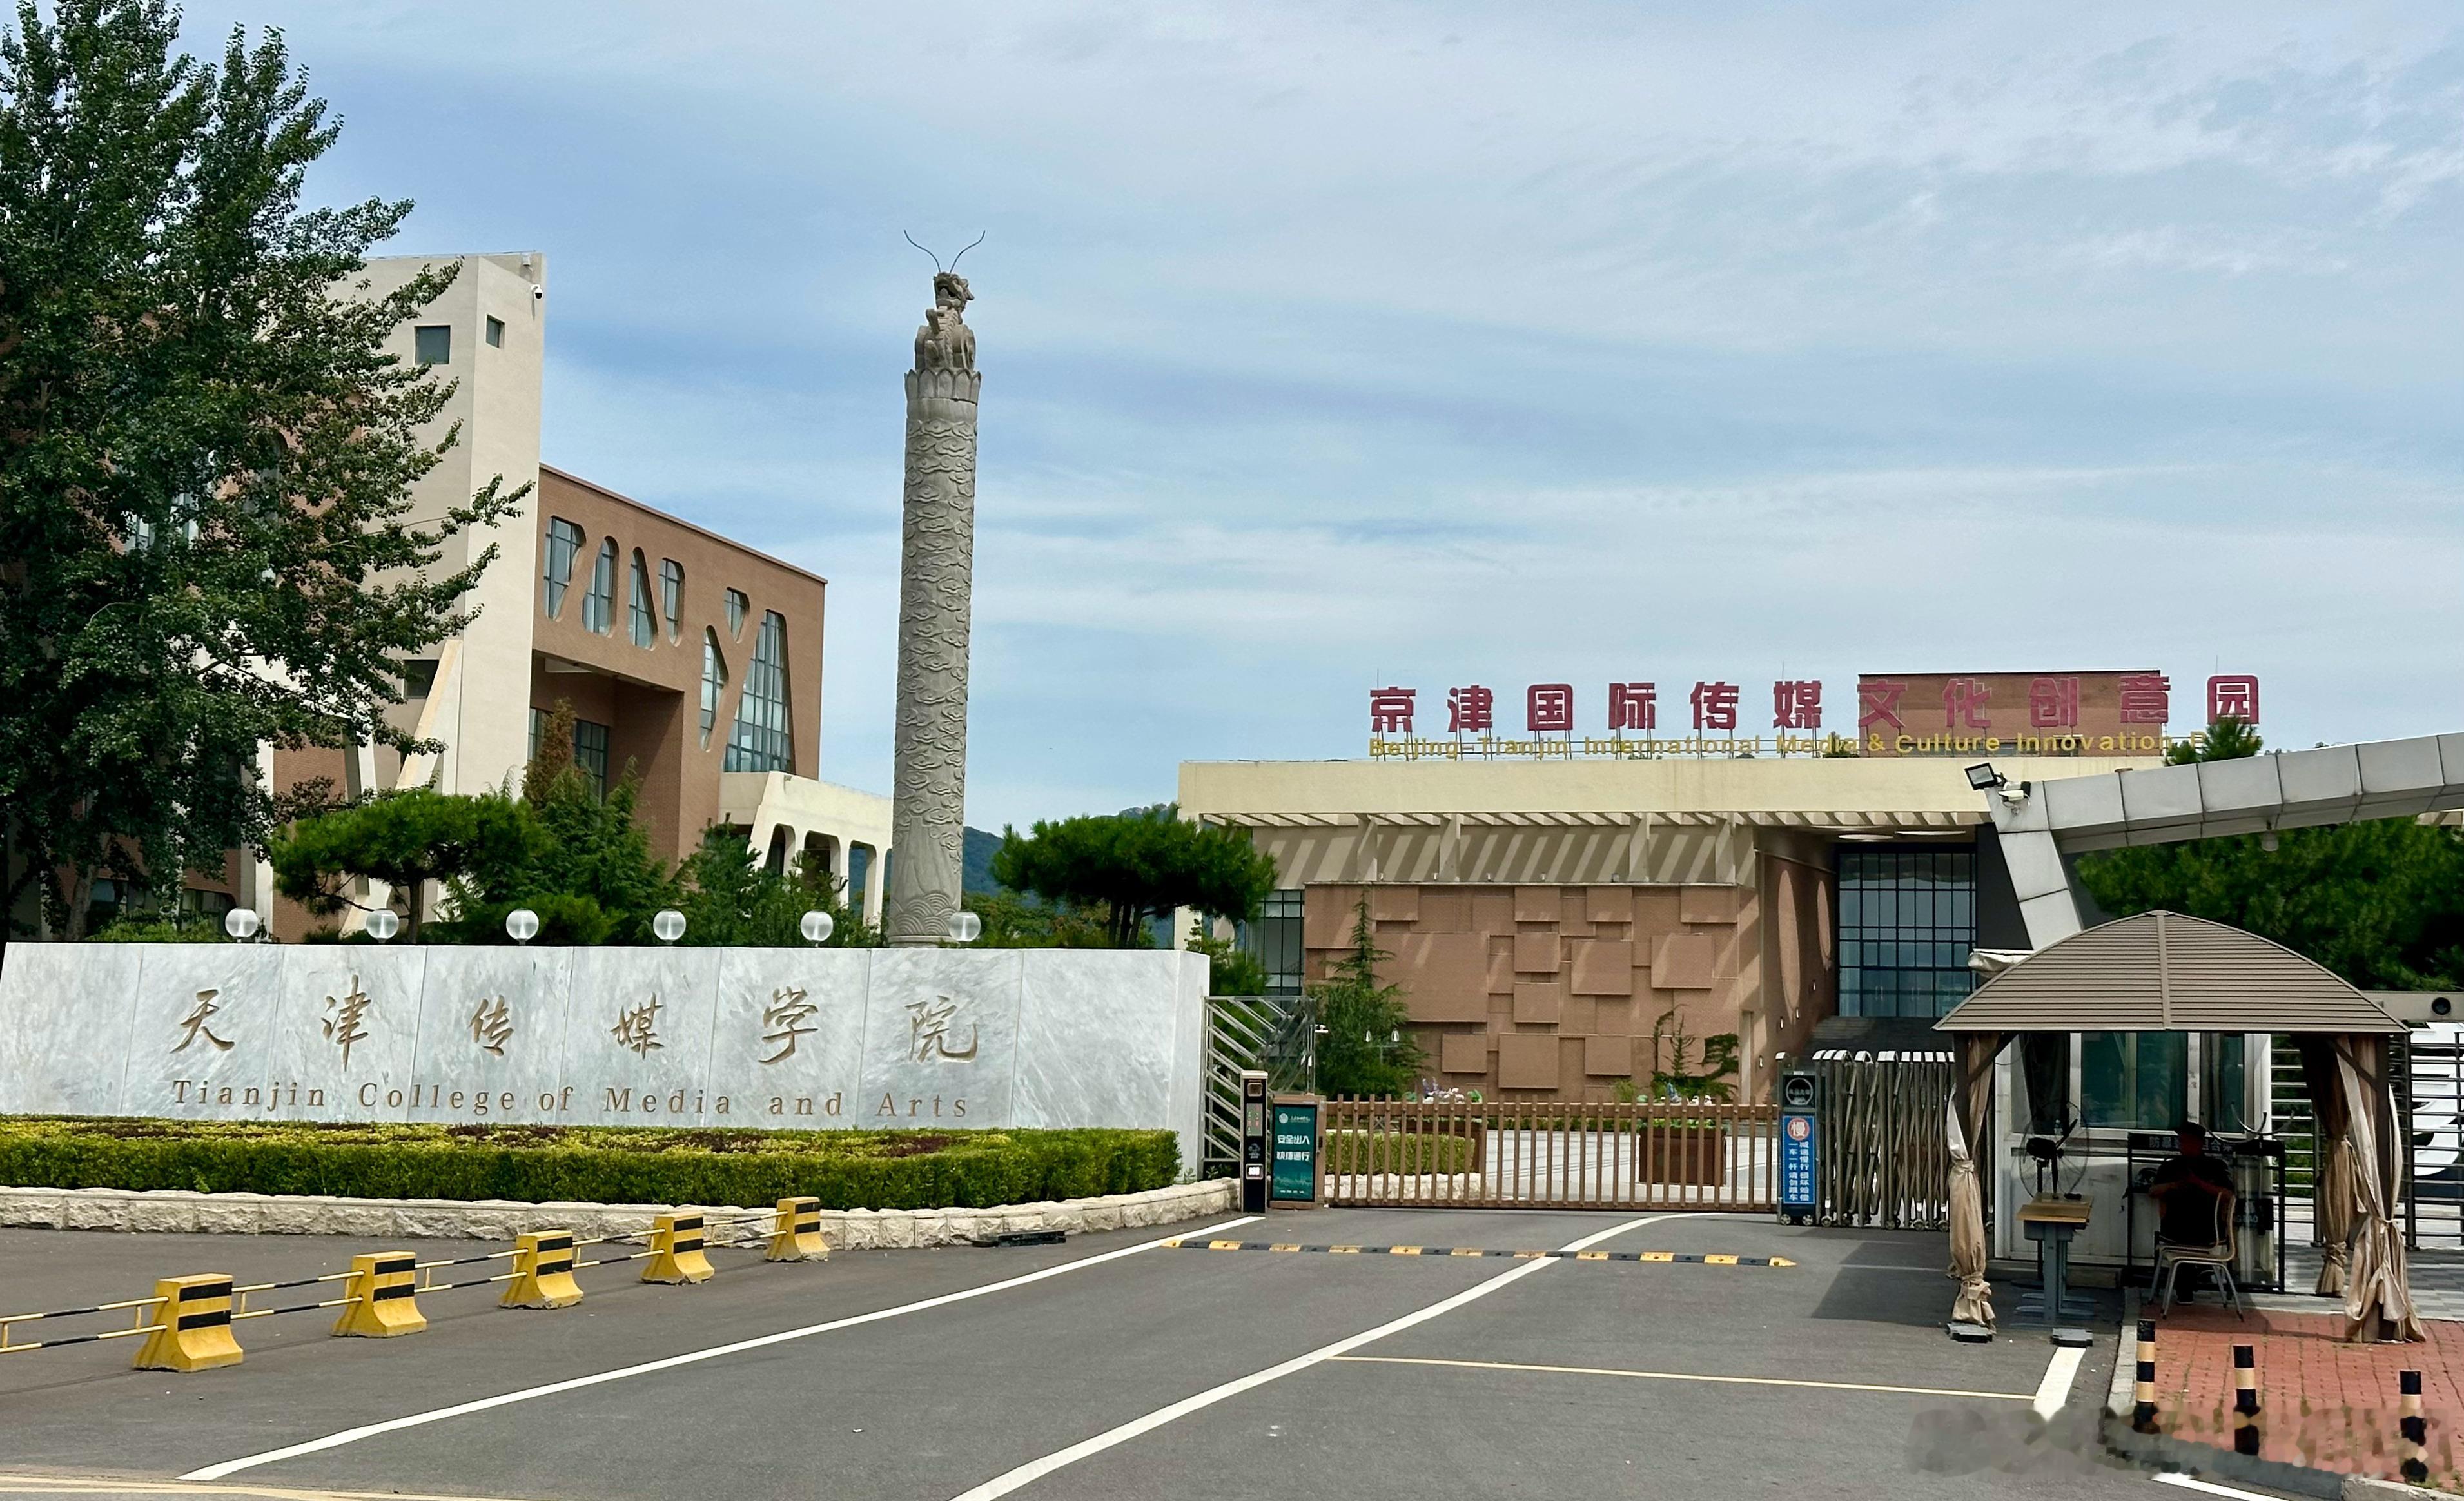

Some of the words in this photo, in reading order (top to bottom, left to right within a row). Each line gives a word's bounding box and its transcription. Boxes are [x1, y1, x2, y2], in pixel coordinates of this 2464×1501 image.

[1369, 674, 2259, 732] 京津国际传媒文化创意园
[1584, 734, 1760, 755] International
[1776, 732, 1857, 754] Media
[1867, 733, 1885, 752] &
[1895, 733, 2000, 754] Culture
[2017, 732, 2173, 752] Innovation
[170, 974, 979, 1072] 天津传媒学院
[173, 1079, 324, 1112] Tianjin
[359, 1082, 515, 1116] College
[539, 1086, 574, 1112] of
[605, 1087, 730, 1115] Media
[769, 1092, 842, 1116] and
[875, 1092, 967, 1118] Arts
[1277, 1134, 1310, 1145] 安全出入
[1790, 1121, 1806, 1137] 慢
